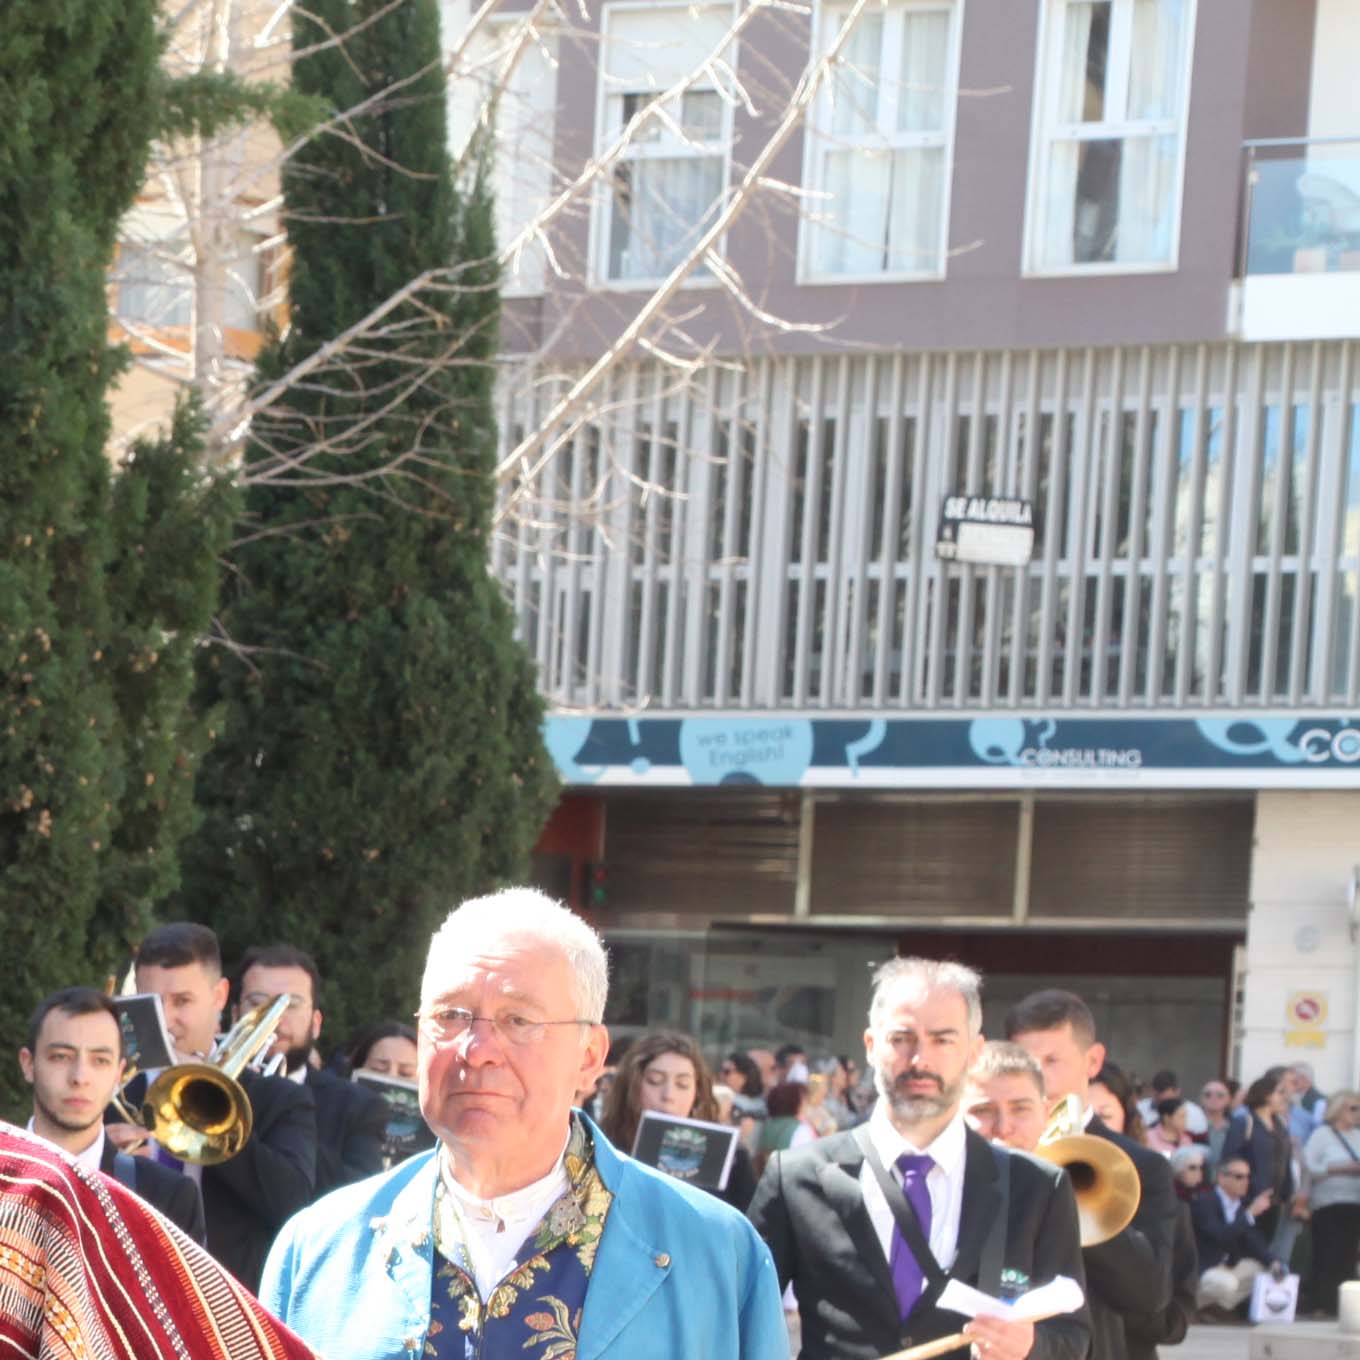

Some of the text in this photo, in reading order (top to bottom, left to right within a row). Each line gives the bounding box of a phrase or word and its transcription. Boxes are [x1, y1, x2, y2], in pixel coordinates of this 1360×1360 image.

[945, 496, 1033, 525] SE ALQUILA
[696, 725, 794, 746] we speak
[1019, 748, 1143, 767] CONSULTING
